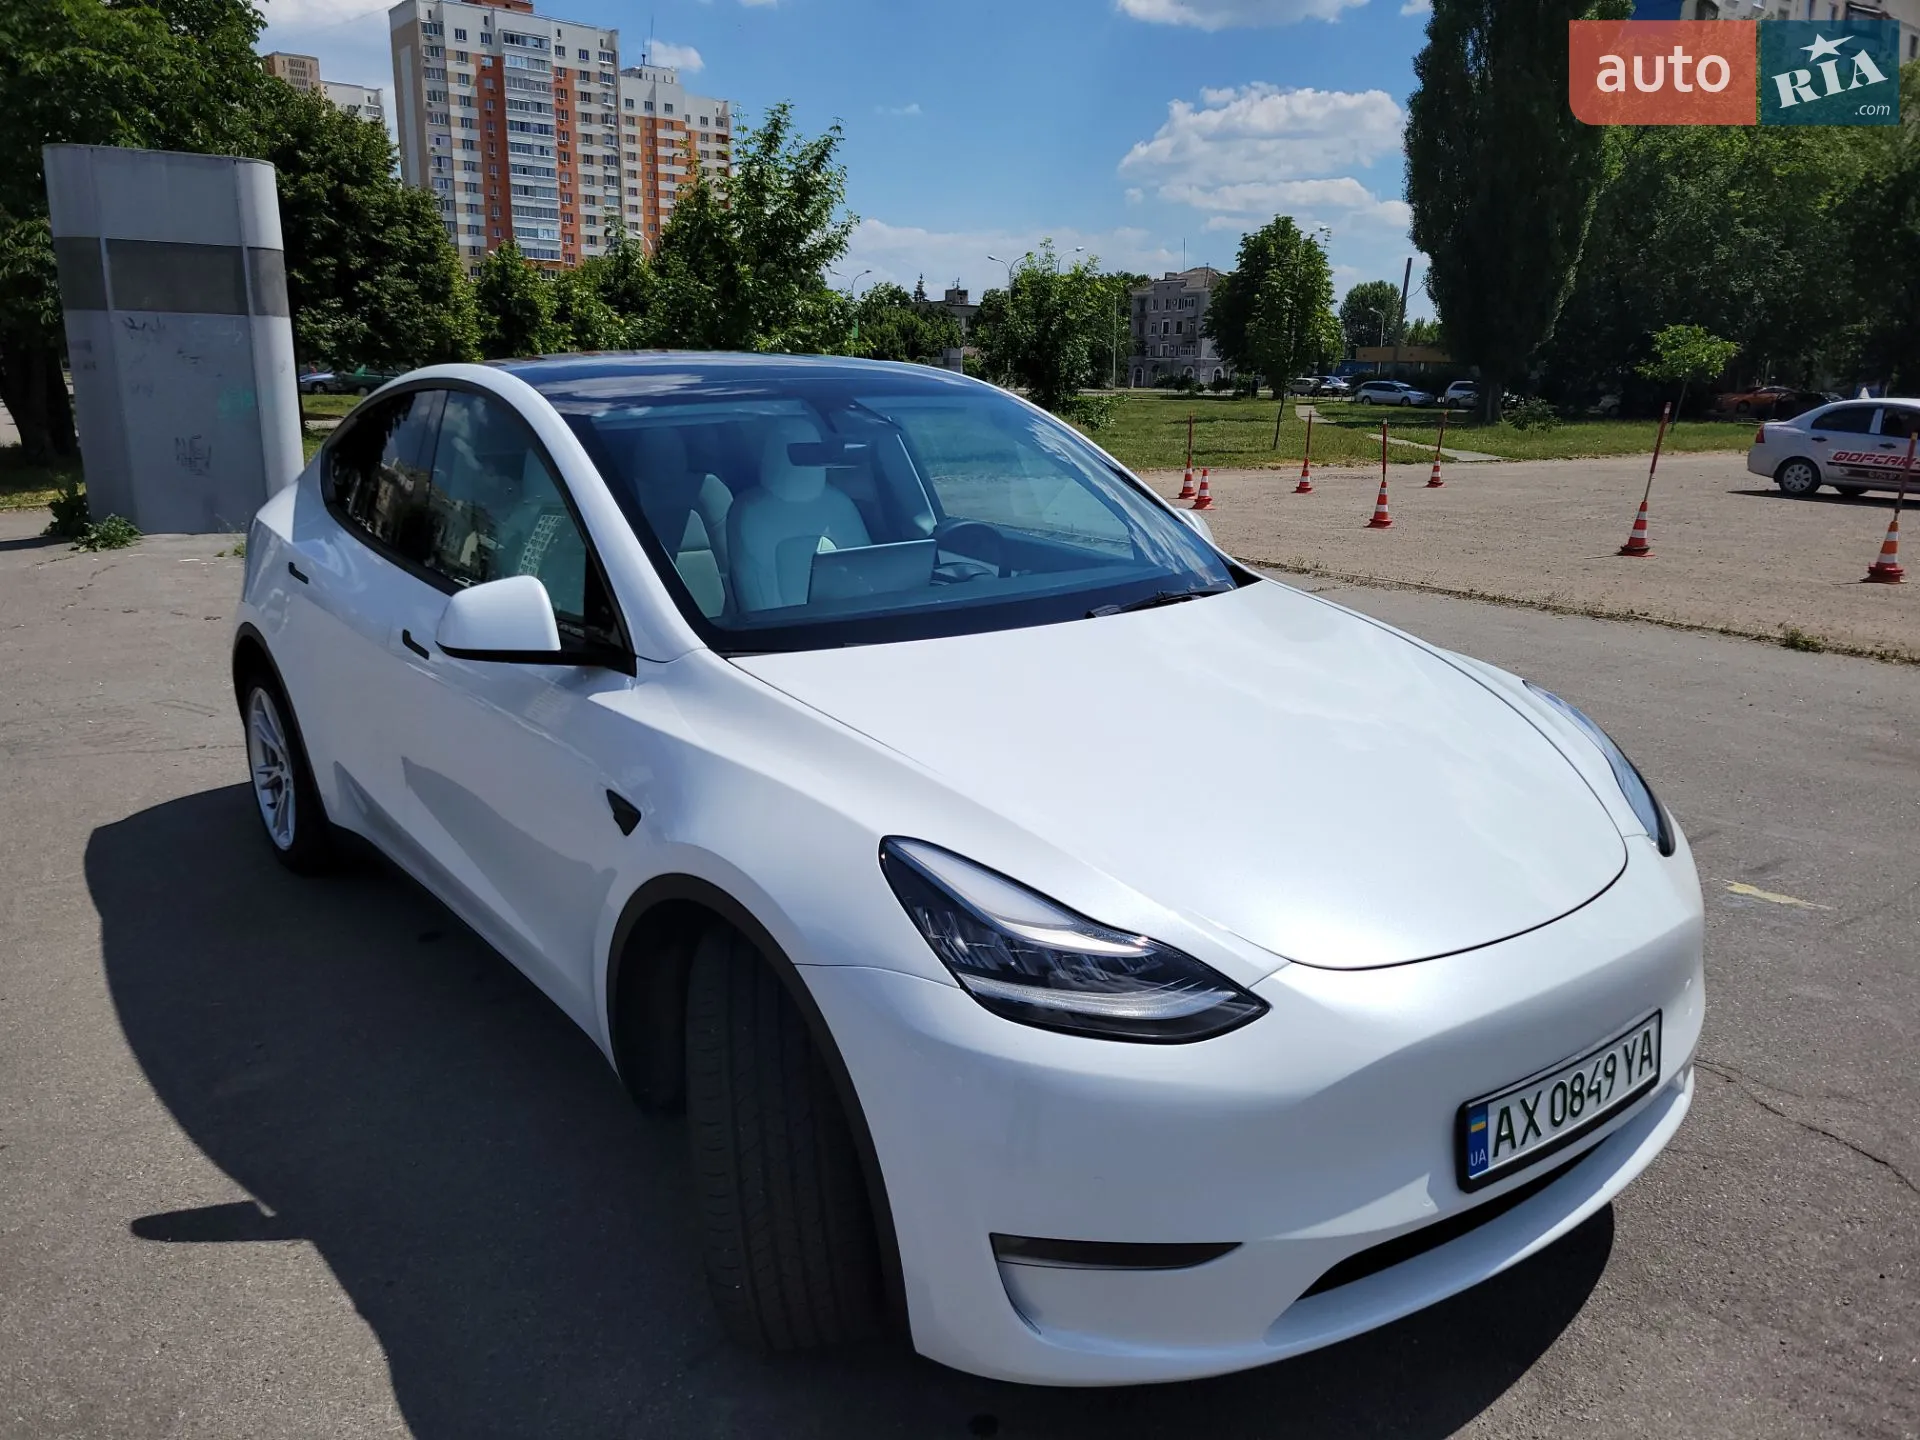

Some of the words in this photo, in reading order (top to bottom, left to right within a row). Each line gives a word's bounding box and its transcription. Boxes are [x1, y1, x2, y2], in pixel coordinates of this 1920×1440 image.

[1492, 1090, 1542, 1157] AX
[1550, 1052, 1616, 1128] 0849
[1623, 1029, 1653, 1085] YA
[1470, 1149, 1487, 1166] UA
